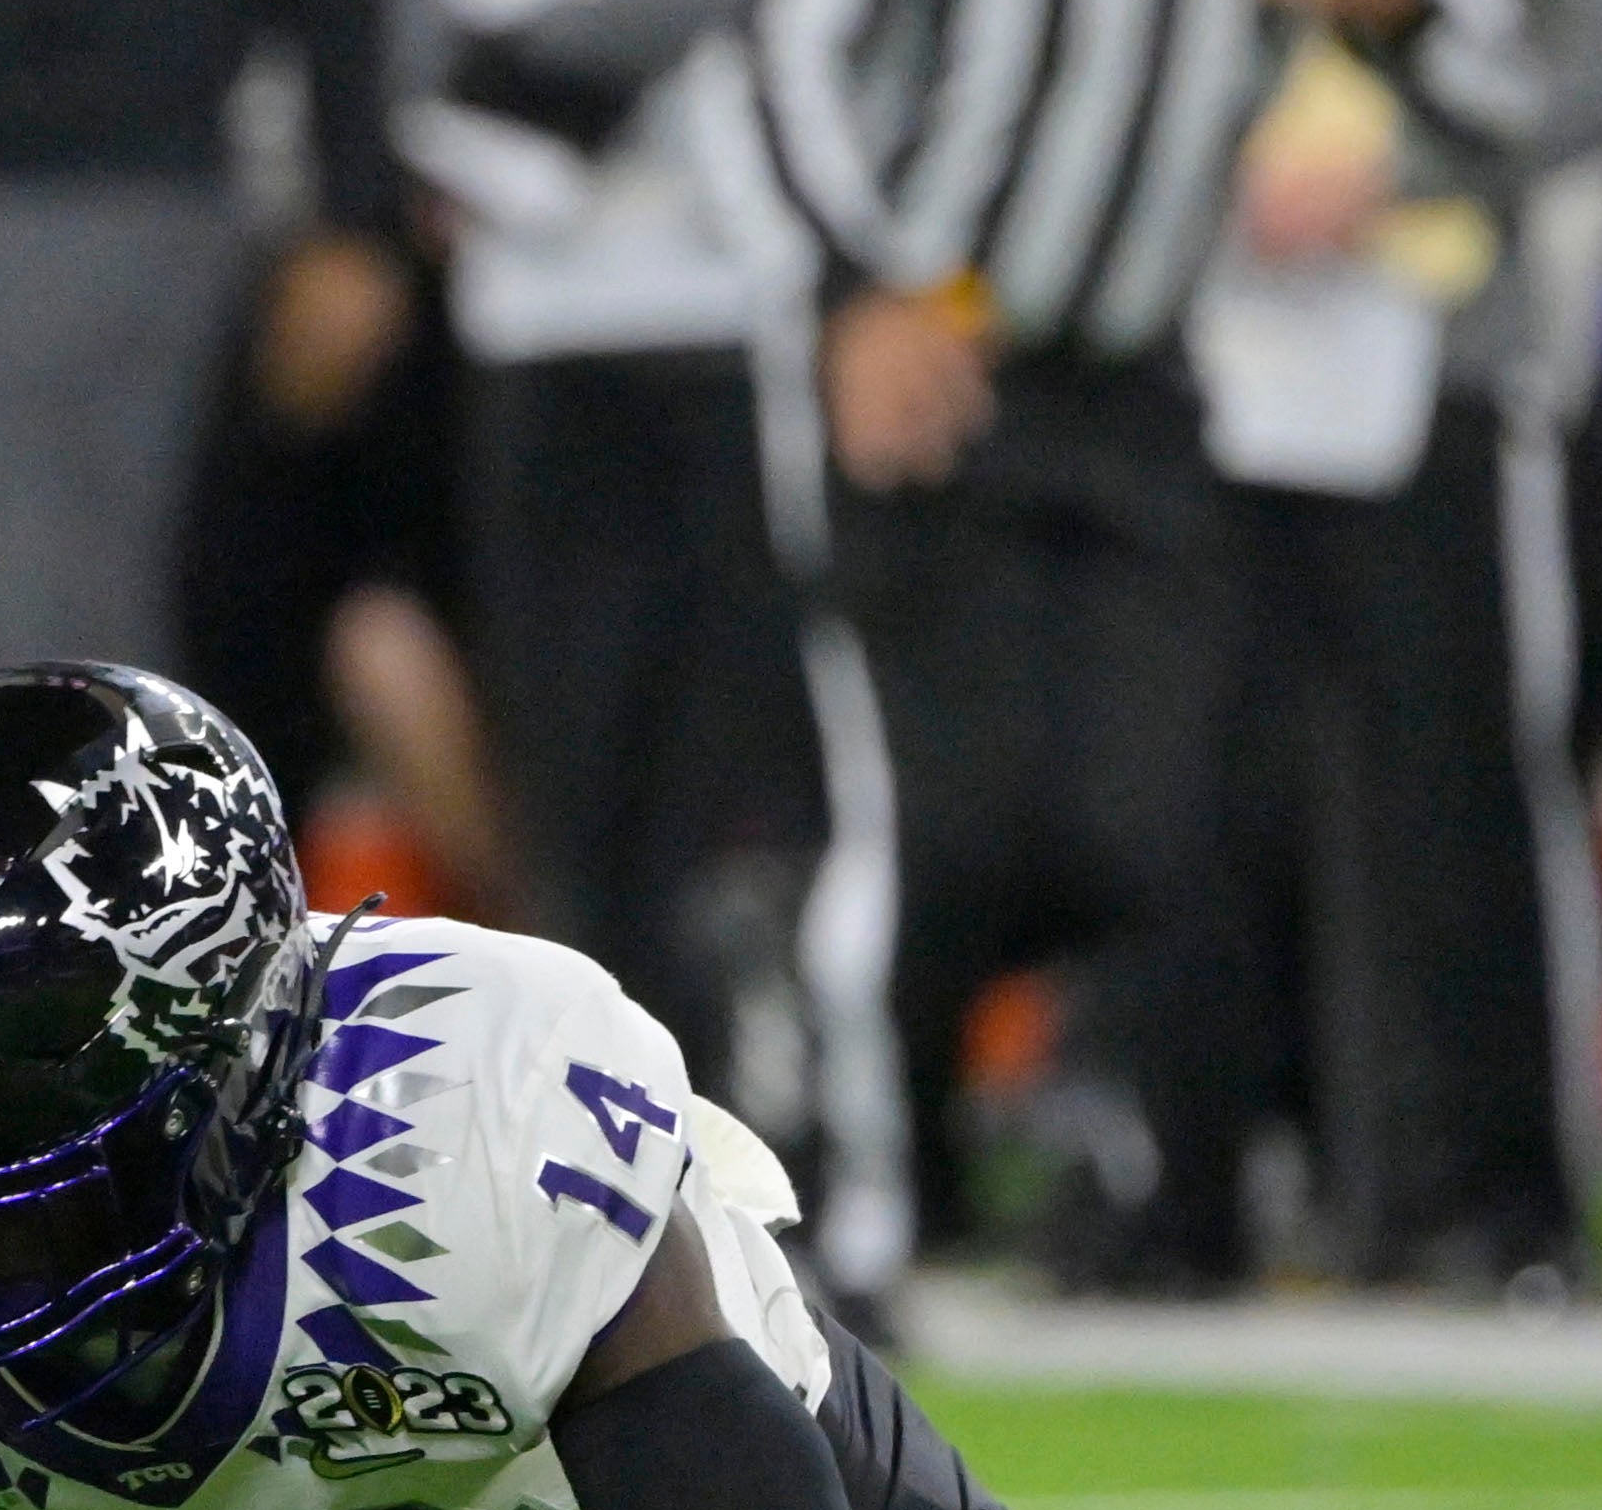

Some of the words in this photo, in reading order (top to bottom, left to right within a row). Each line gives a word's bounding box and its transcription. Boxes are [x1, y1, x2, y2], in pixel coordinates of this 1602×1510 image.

[536, 1059, 683, 1248] 14
[283, 1363, 513, 1434] 2023
[116, 1461, 194, 1491] TCU
